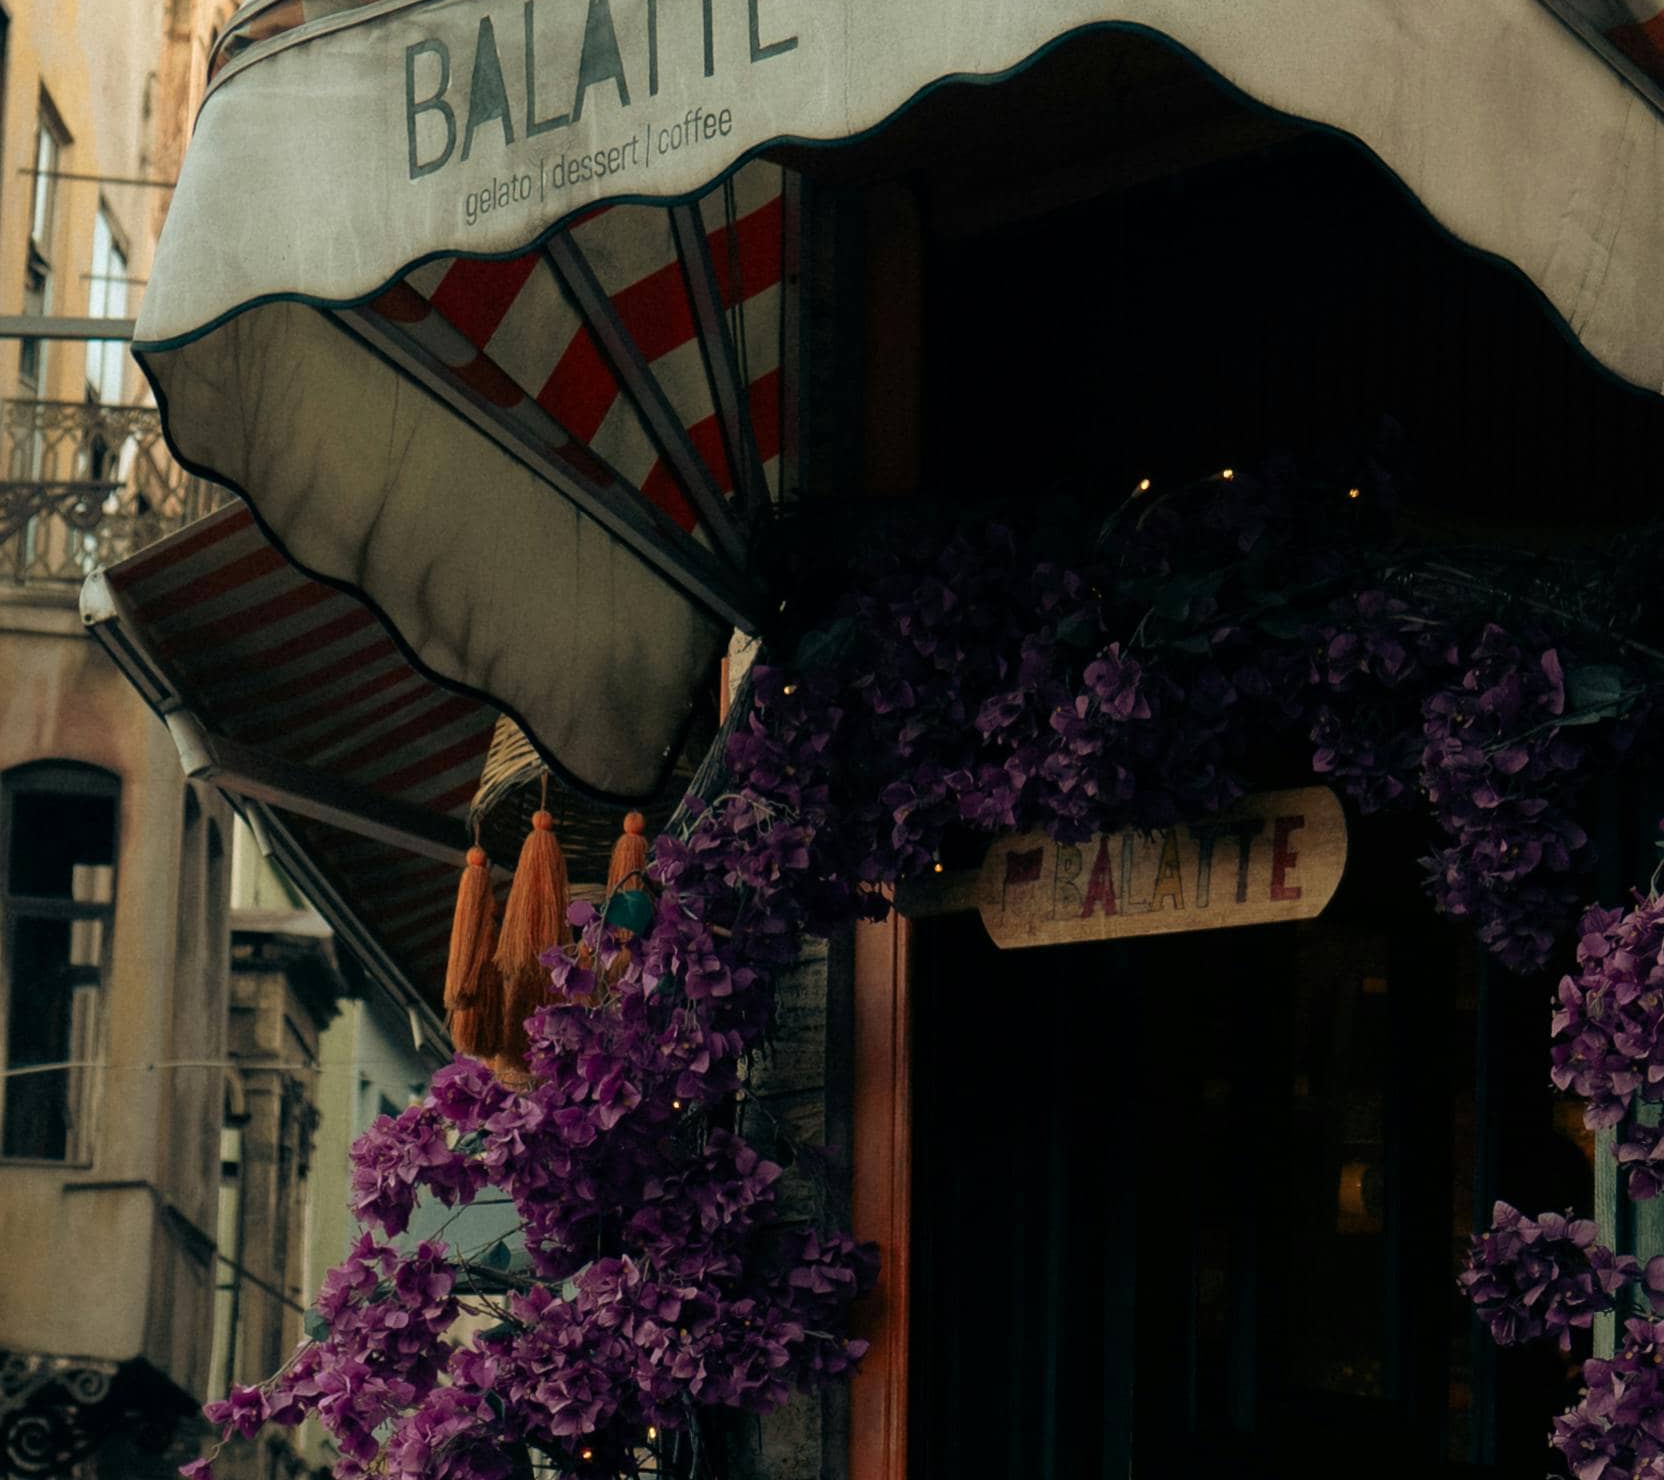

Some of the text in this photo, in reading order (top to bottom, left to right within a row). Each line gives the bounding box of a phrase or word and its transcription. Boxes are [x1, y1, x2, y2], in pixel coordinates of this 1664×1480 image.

[465, 173, 532, 225] gelato
[552, 135, 640, 189] dessert
[657, 106, 733, 154] coffee
